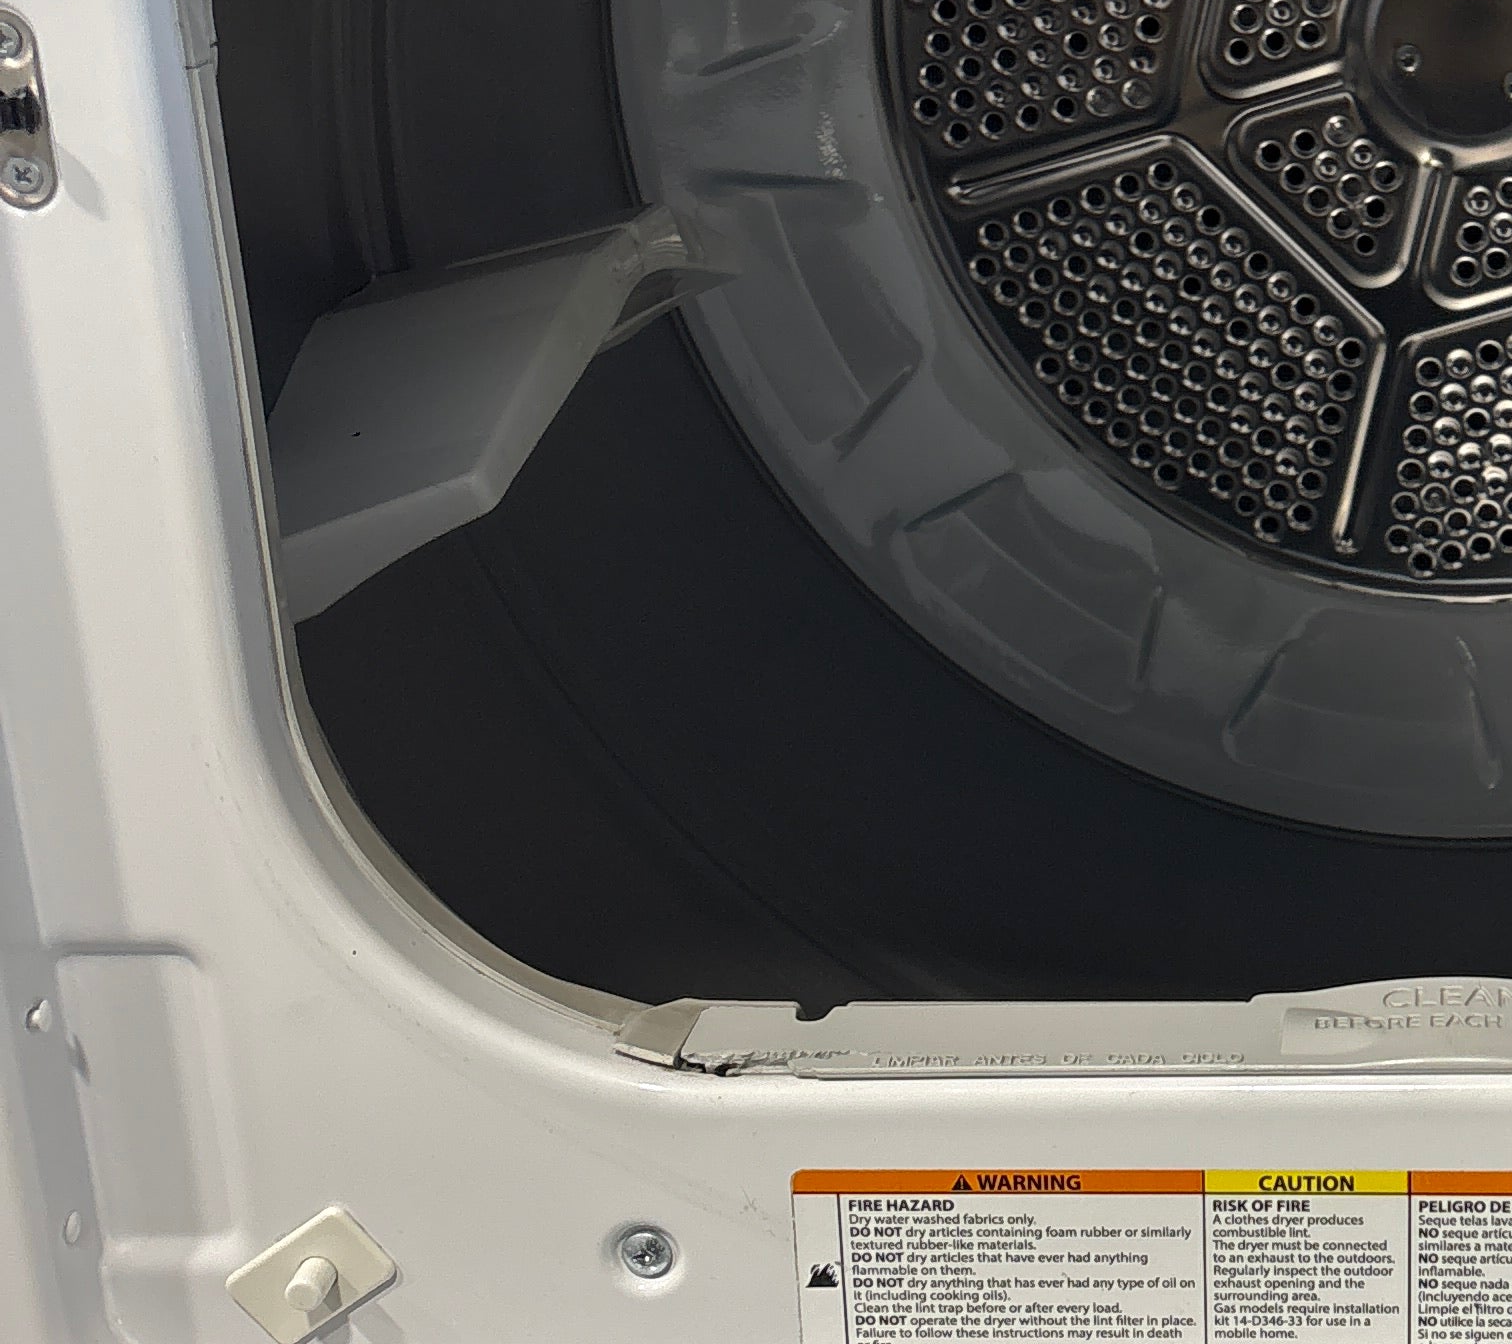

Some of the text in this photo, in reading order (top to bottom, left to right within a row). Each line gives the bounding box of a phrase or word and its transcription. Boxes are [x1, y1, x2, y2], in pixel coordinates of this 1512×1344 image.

[1314, 1016, 1421, 1030] BEFORE
[1430, 1015, 1502, 1028] EACH
[977, 1175, 1082, 1190] WARNING
[1258, 1175, 1355, 1192] CAUTION
[848, 1200, 954, 1211] FIRE HAZARD
[1212, 1200, 1310, 1211] RISK OF FIRE
[1418, 1202, 1486, 1214] PELIGRO
[1489, 1202, 1510, 1214] DE
[848, 1214, 1036, 1226] Dry water washed fabrics only.
[1224, 1215, 1269, 1224] clothes
[1271, 1215, 1304, 1227] dryer
[1307, 1215, 1364, 1227] produces
[1418, 1216, 1457, 1229] Seque
[1459, 1216, 1488, 1227] telas
[849, 1226, 1191, 1239] DO NOT dry articles containing foam rubber or similarly
[1212, 1227, 1310, 1237] combustible lint.
[1418, 1228, 1439, 1239] NO
[1442, 1230, 1478, 1242] seque
[850, 1240, 1036, 1250] textured rubber-like materials.
[1212, 1240, 1387, 1252] The dryer must be connected
[1418, 1241, 1471, 1252] similares
[851, 1252, 872, 1262] DO
[875, 1252, 904, 1262] NOT
[906, 1252, 927, 1265] dry
[930, 1252, 974, 1262] articles
[977, 1252, 1002, 1262] that
[1005, 1252, 1035, 1262] have
[1067, 1252, 1090, 1262] had
[1093, 1252, 1148, 1265] anything
[851, 1265, 976, 1275] flammable on them.
[1214, 1328, 1298, 1338] mobile home.
